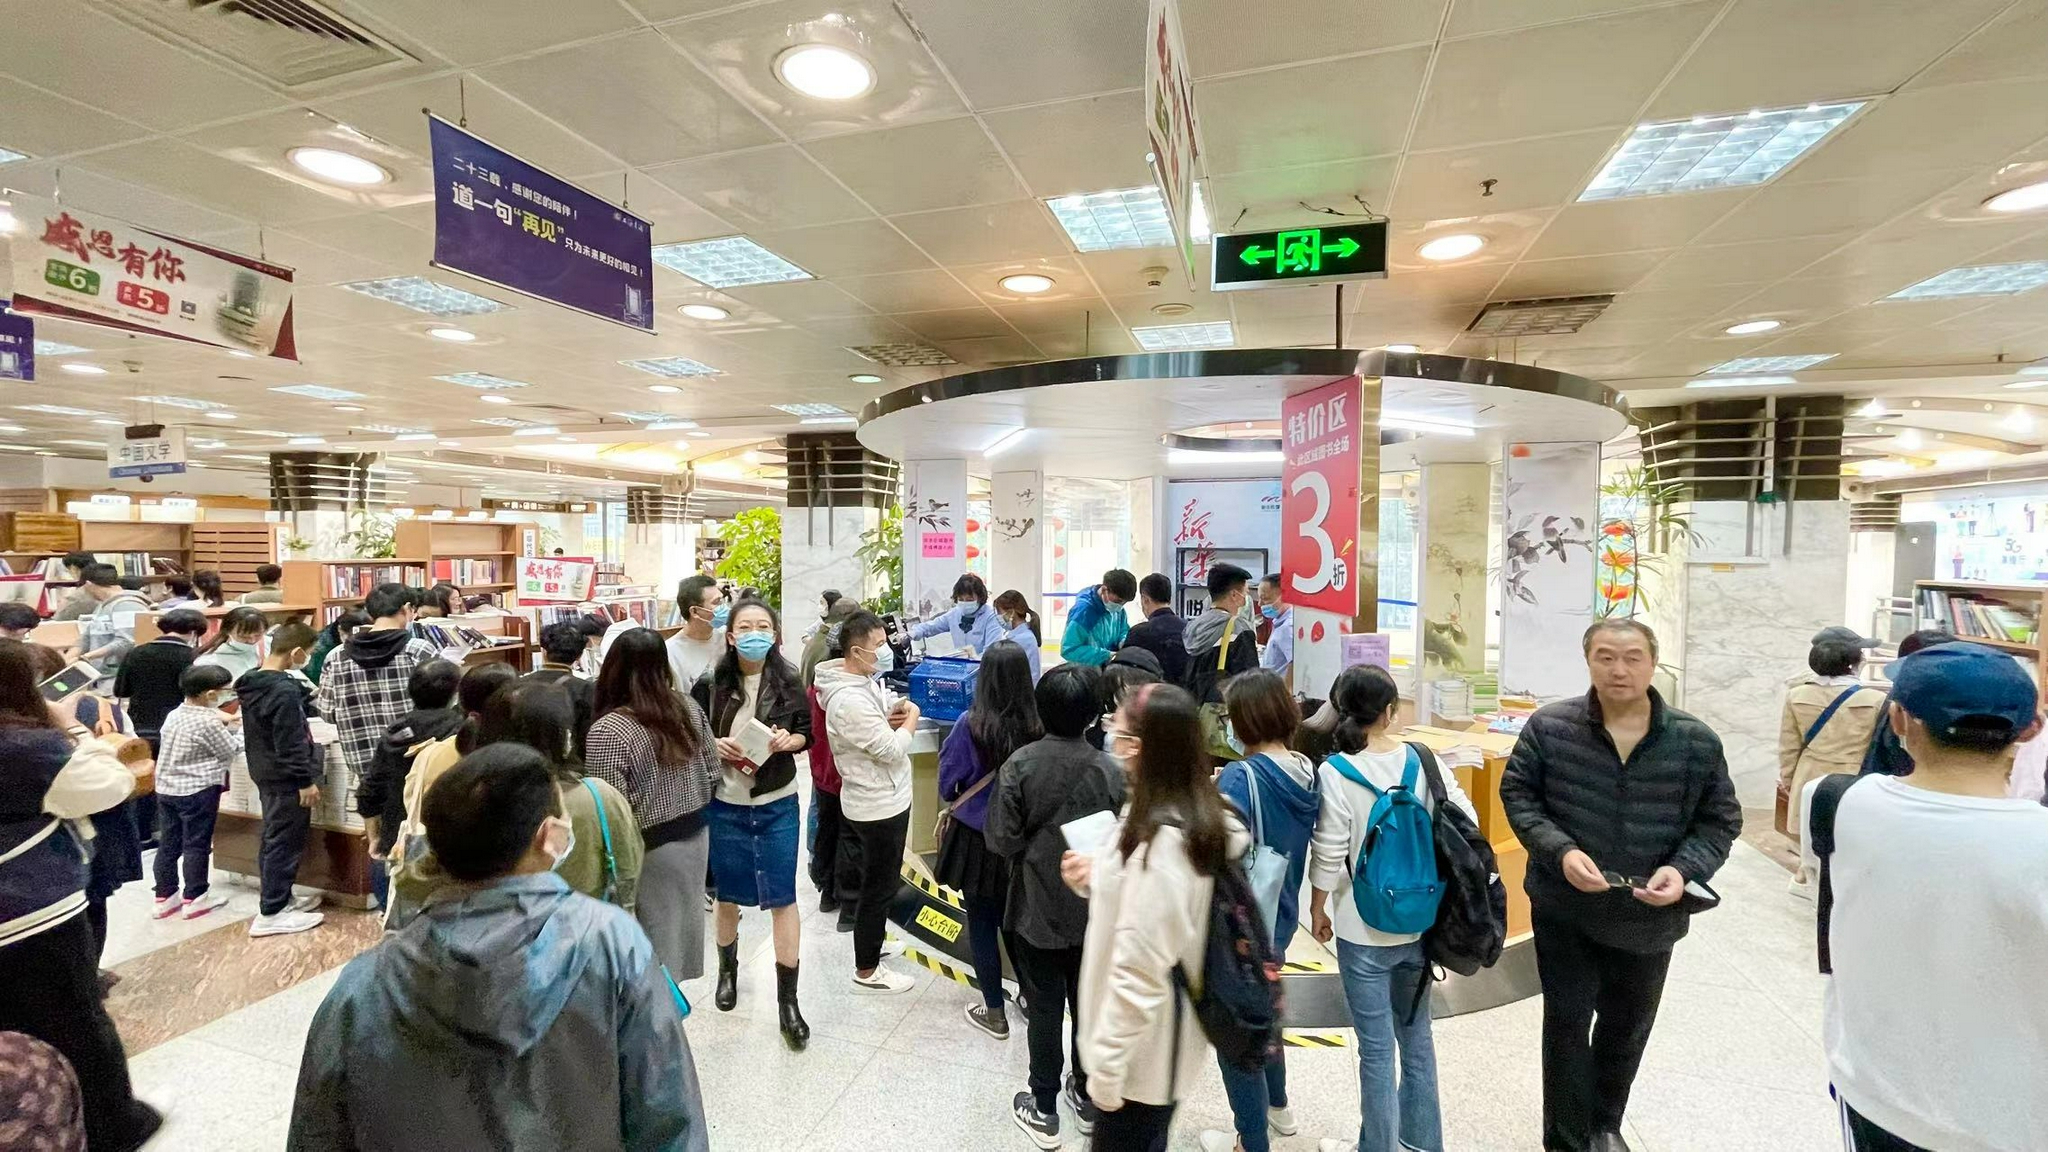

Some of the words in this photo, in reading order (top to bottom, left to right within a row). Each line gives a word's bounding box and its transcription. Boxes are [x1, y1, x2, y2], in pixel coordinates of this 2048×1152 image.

[40, 212, 186, 284] 感恩有你
[1288, 392, 1347, 447] 特价区
[120, 440, 171, 461] 中国文学
[919, 909, 959, 939] 小心台阶
